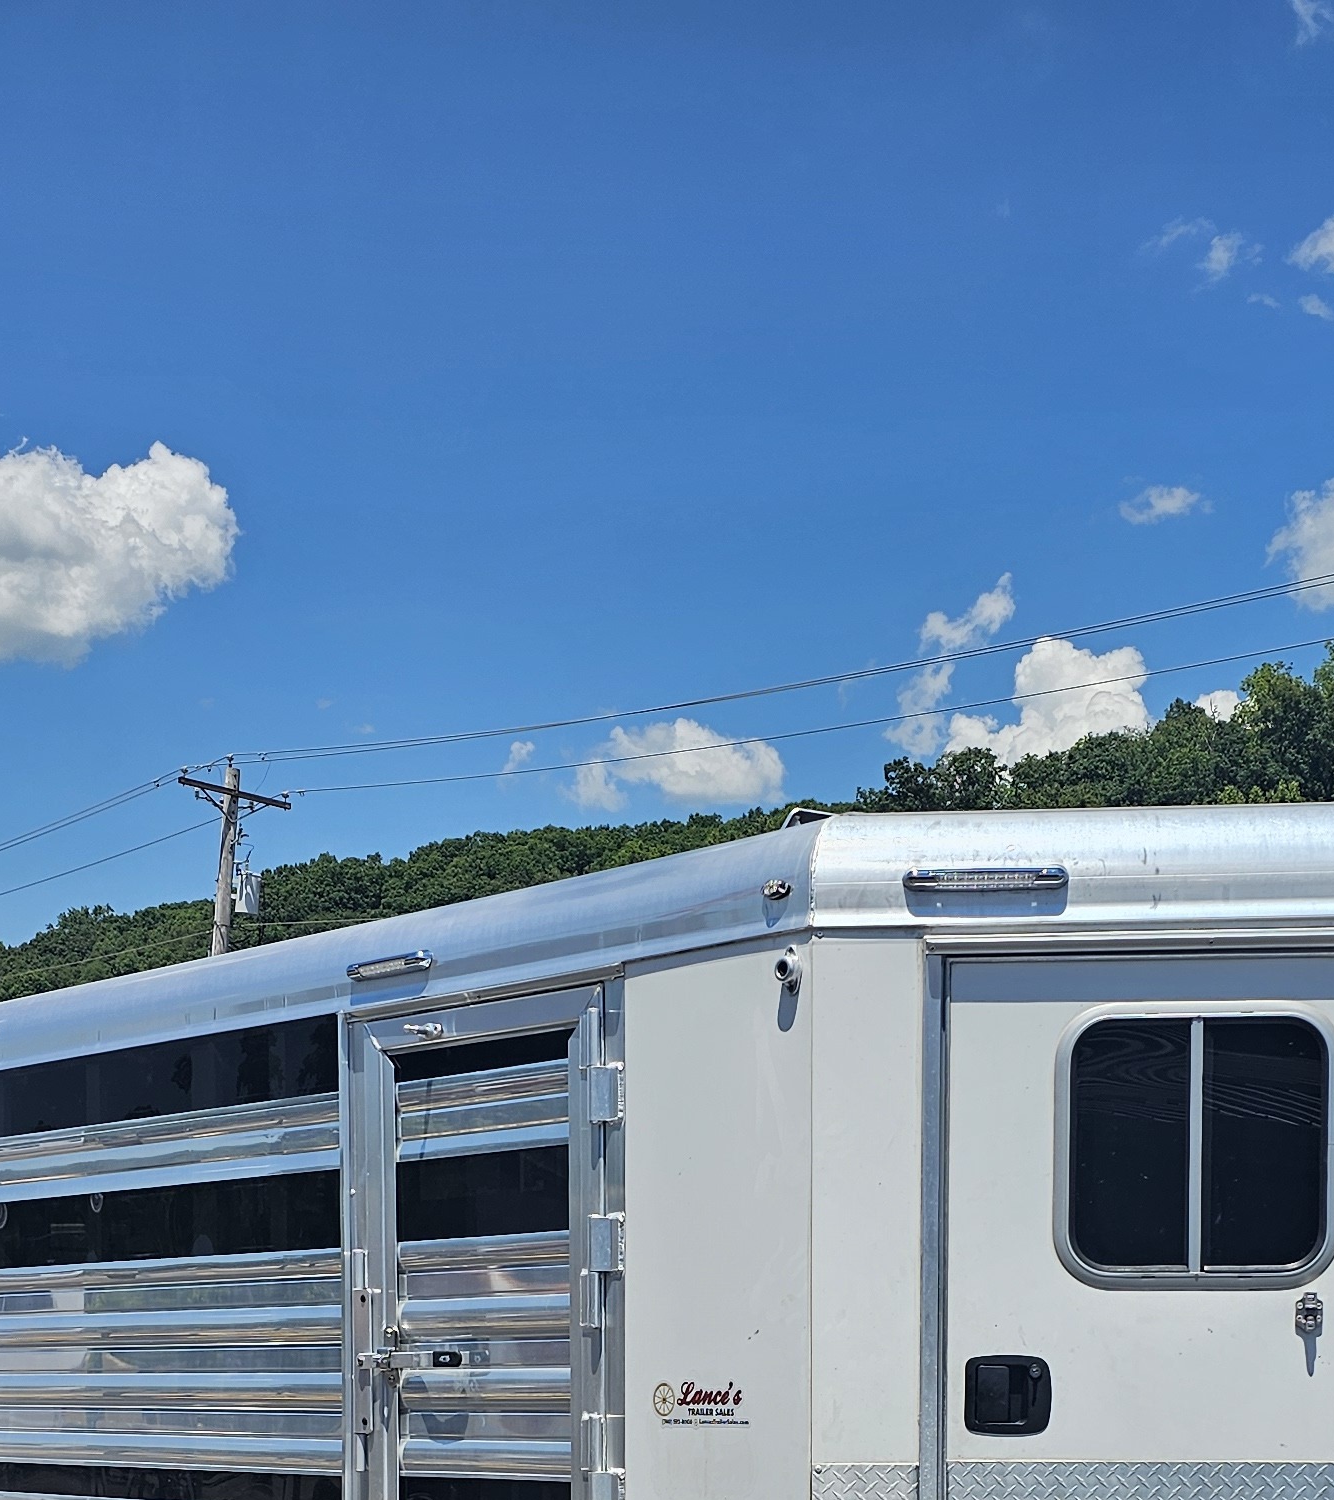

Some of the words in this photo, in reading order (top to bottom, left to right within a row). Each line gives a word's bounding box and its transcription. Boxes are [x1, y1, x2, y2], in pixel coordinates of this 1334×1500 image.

[677, 1381, 742, 1406] Lance's
[688, 1408, 713, 1416] TRAILER
[715, 1408, 735, 1416] SALES
